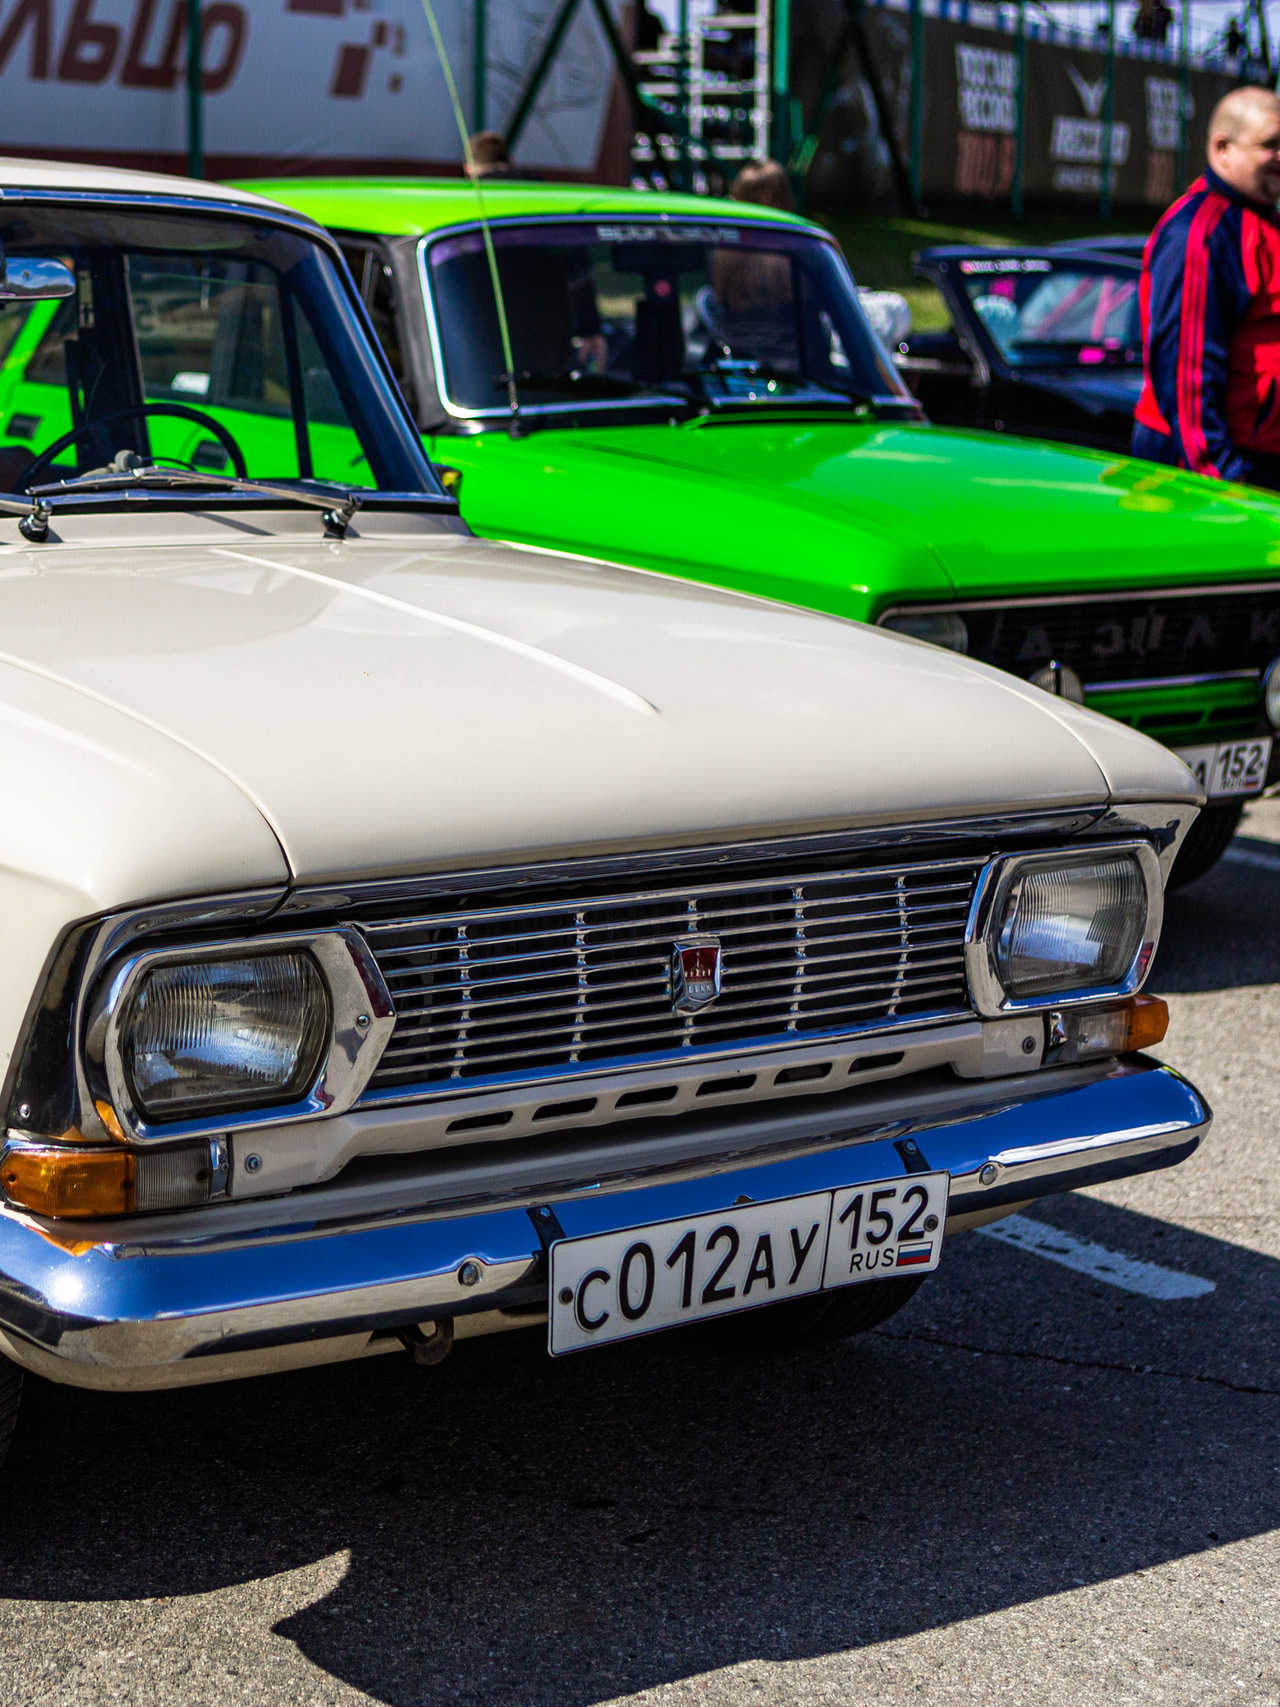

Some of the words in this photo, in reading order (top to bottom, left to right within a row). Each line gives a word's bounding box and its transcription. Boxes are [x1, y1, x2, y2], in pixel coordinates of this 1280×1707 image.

[1219, 744, 1262, 780] 152
[576, 1223, 819, 1331] С012АУ
[838, 1185, 929, 1250] 152
[850, 1248, 894, 1273] RUS
